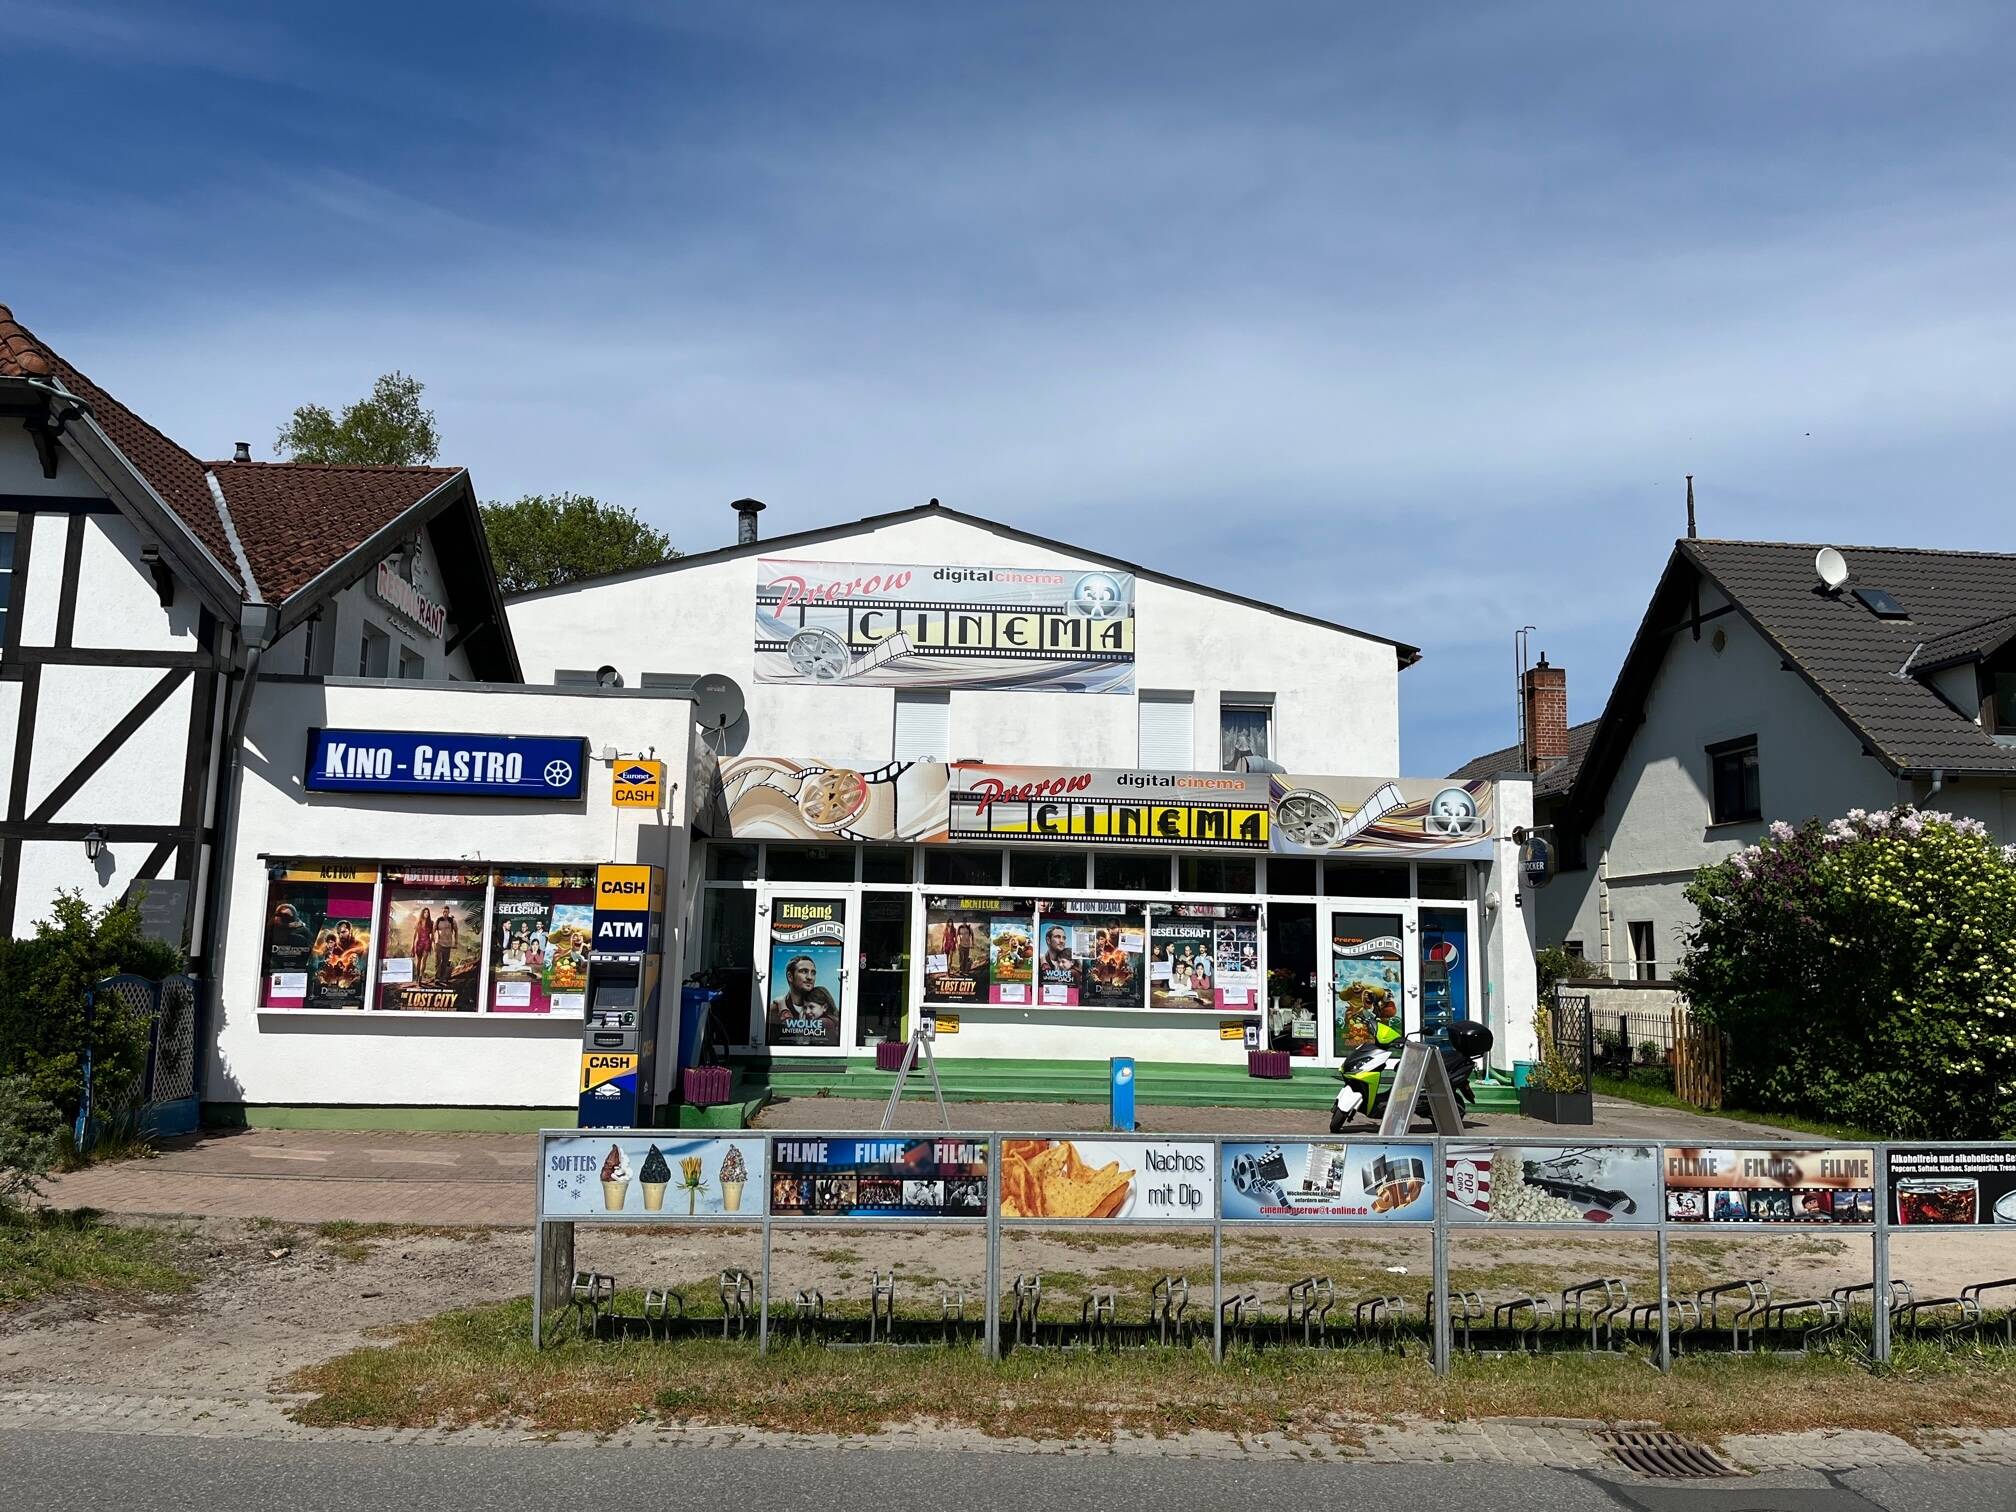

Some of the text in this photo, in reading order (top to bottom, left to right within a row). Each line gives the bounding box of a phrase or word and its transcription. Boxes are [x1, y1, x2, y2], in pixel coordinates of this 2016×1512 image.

[933, 567, 1066, 585] digitalcinema
[766, 568, 914, 620] Prerow
[859, 611, 1124, 650] CINEMA
[1117, 774, 1245, 791] digitalcinema
[615, 789, 655, 801] CASH
[970, 773, 1092, 816] Prerow
[1036, 805, 1261, 841] CINEMA
[320, 864, 357, 879] ACTION
[601, 881, 645, 894] CASH
[1070, 901, 1122, 913] ACTION DRAMA
[1514, 893, 1522, 908] 5
[782, 904, 832, 920] Eingang
[599, 921, 643, 938] ATM
[1151, 928, 1211, 938] GESELLSCHAFT
[940, 980, 960, 992] LOST
[960, 981, 976, 992] CITY
[408, 992, 434, 1006] LOST
[434, 993, 458, 1008] CITY
[786, 1019, 823, 1029] WOLKE
[803, 1028, 826, 1036] DACH
[590, 1056, 630, 1068] CASH
[777, 1142, 984, 1164] FILME FILME FILME
[1145, 1149, 1205, 1171] Nachos
[1891, 1154, 1938, 1164] Alkoholfreie
[1939, 1154, 1954, 1164] und
[1955, 1154, 2004, 1163] alkoholische
[551, 1155, 597, 1172] SOFTEIS
[1668, 1157, 1869, 1178] FILME FILME FILME
[1456, 1171, 1464, 1191] CORN
[1464, 1172, 1474, 1194] POP
[1148, 1184, 1202, 1209] mit Dip
[1260, 1206, 1368, 1216] cinemaprerow@t-online.de
